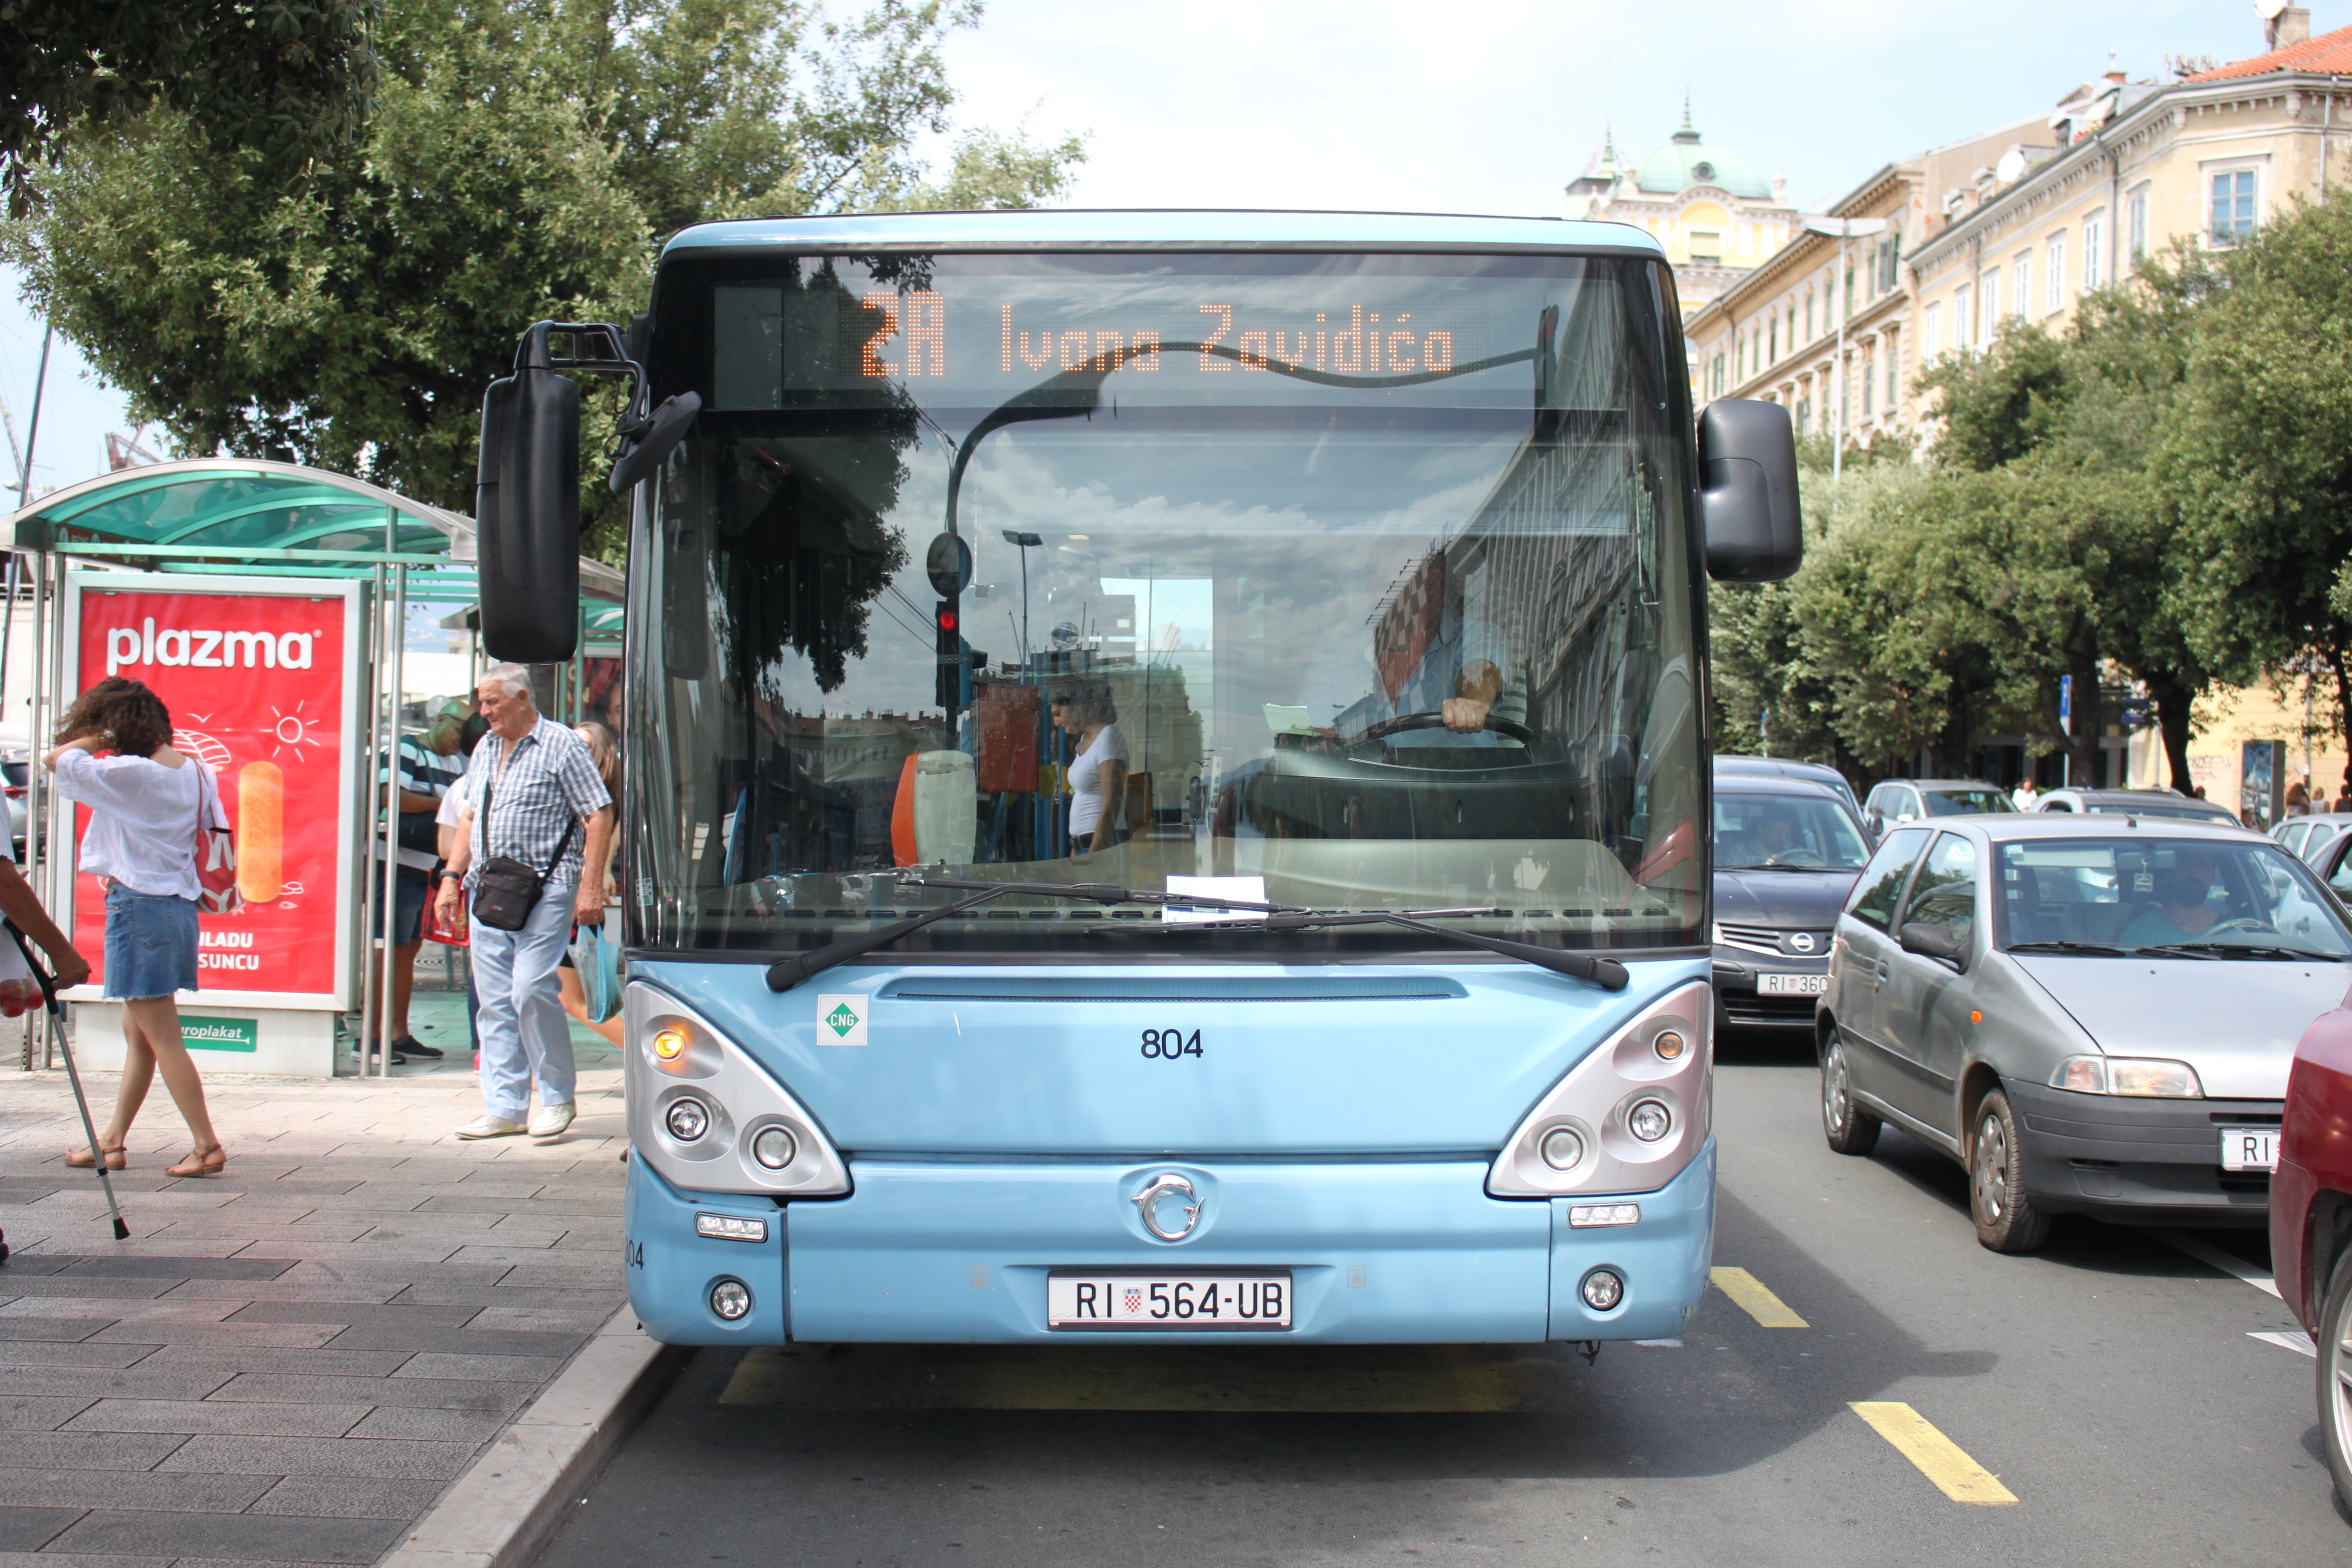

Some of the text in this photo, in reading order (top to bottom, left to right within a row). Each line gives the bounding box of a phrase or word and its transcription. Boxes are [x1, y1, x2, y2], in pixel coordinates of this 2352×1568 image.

[862, 291, 1452, 376] 2A Ivana Zavidića
[106, 616, 313, 677] plazma
[198, 953, 260, 971] SUNCU
[1769, 975, 1785, 992] RI
[830, 1013, 855, 1027] CNG
[1141, 1028, 1204, 1060] 804
[2243, 1136, 2269, 1162] RI
[1076, 1281, 1283, 1319] RI 564-UB
